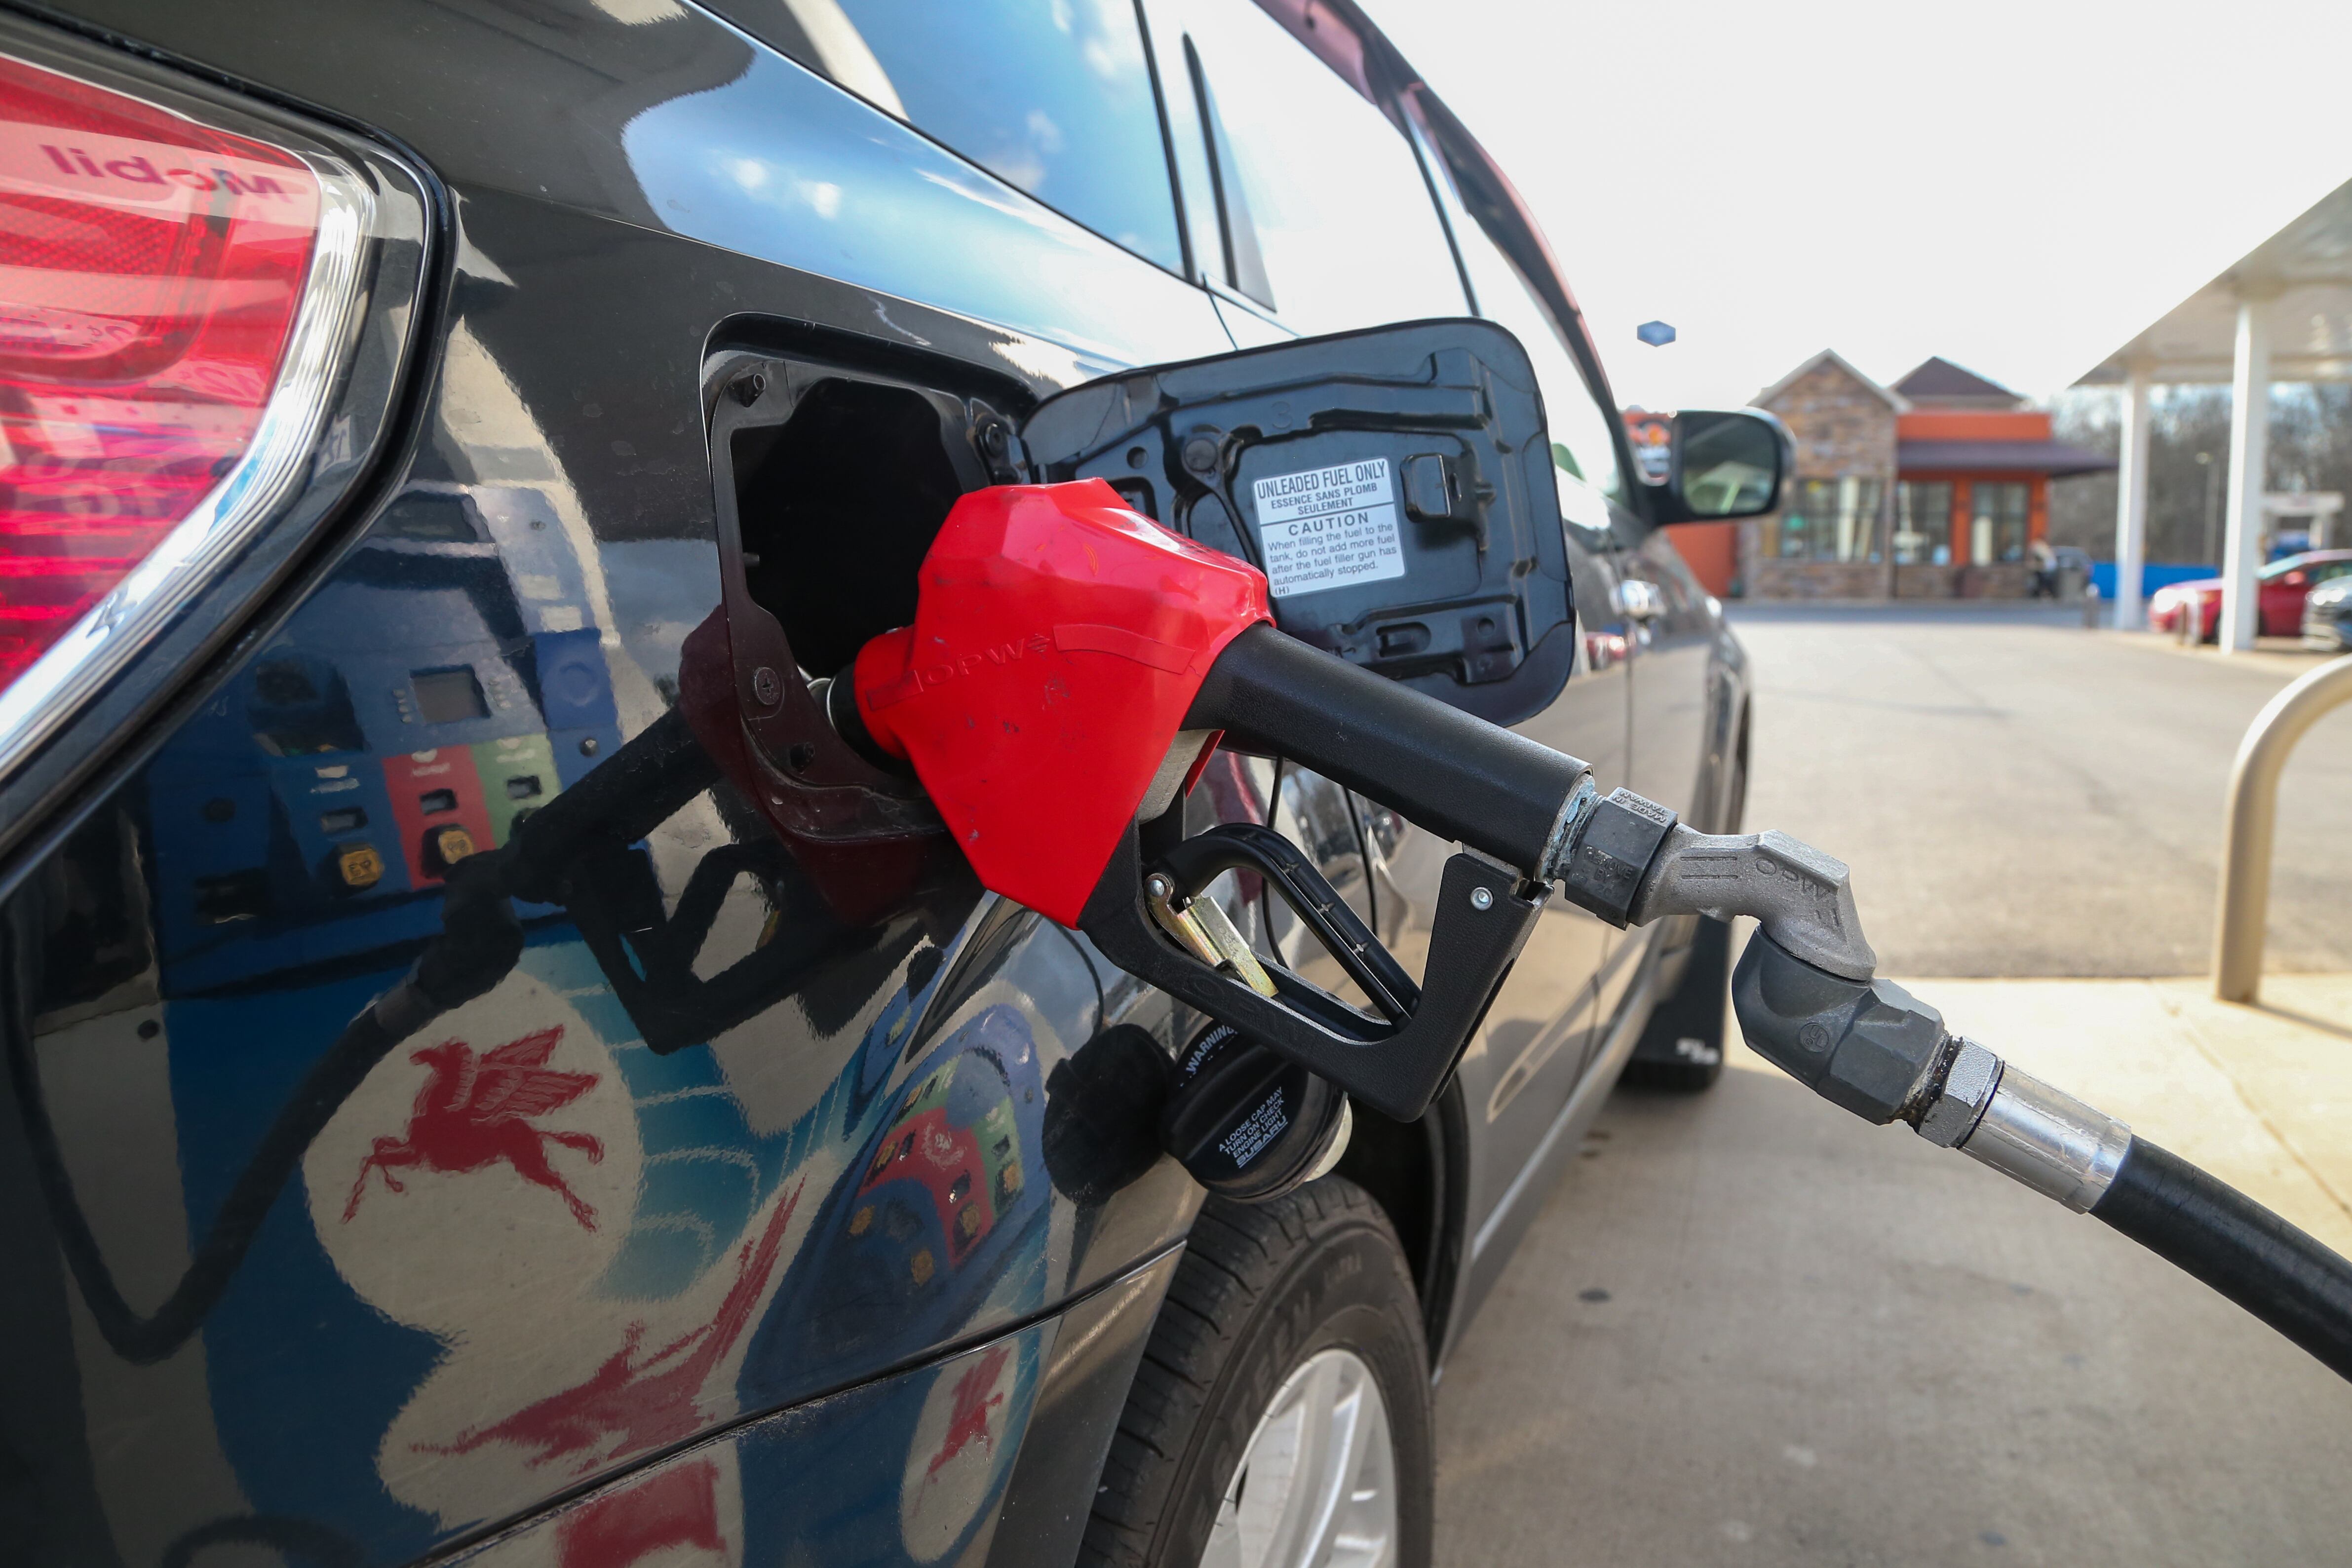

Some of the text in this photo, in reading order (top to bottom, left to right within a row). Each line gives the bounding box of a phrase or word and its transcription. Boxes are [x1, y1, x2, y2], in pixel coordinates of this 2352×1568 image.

[1257, 461, 1385, 499] UNLEADED FUEL ONLY
[1272, 483, 1377, 509] ESSENCE SANS PLOMB
[1298, 497, 1353, 515] SEULEMENT
[1268, 523, 1393, 551] When filling the fuel to the
[1288, 512, 1369, 535] CAUTION
[1270, 534, 1395, 563] tank, do not add more fuel
[1272, 546, 1397, 574] after the fuel filler gun has
[1274, 560, 1378, 586] automatically stopped.
[1274, 586, 1290, 596] (H)
[924, 638, 1025, 685] OPW
[1613, 795, 1667, 823] MADE IN
[1620, 791, 1665, 815] TAIWAN
[1756, 857, 1831, 900] OPW
[1219, 1086, 1282, 1152] A LOOSE CAP MAY
[1225, 1097, 1284, 1155] TURN ON CHECK
[1233, 1108, 1282, 1158] ENGINE LIGHT
[1236, 1115, 1287, 1165] SUBARU
